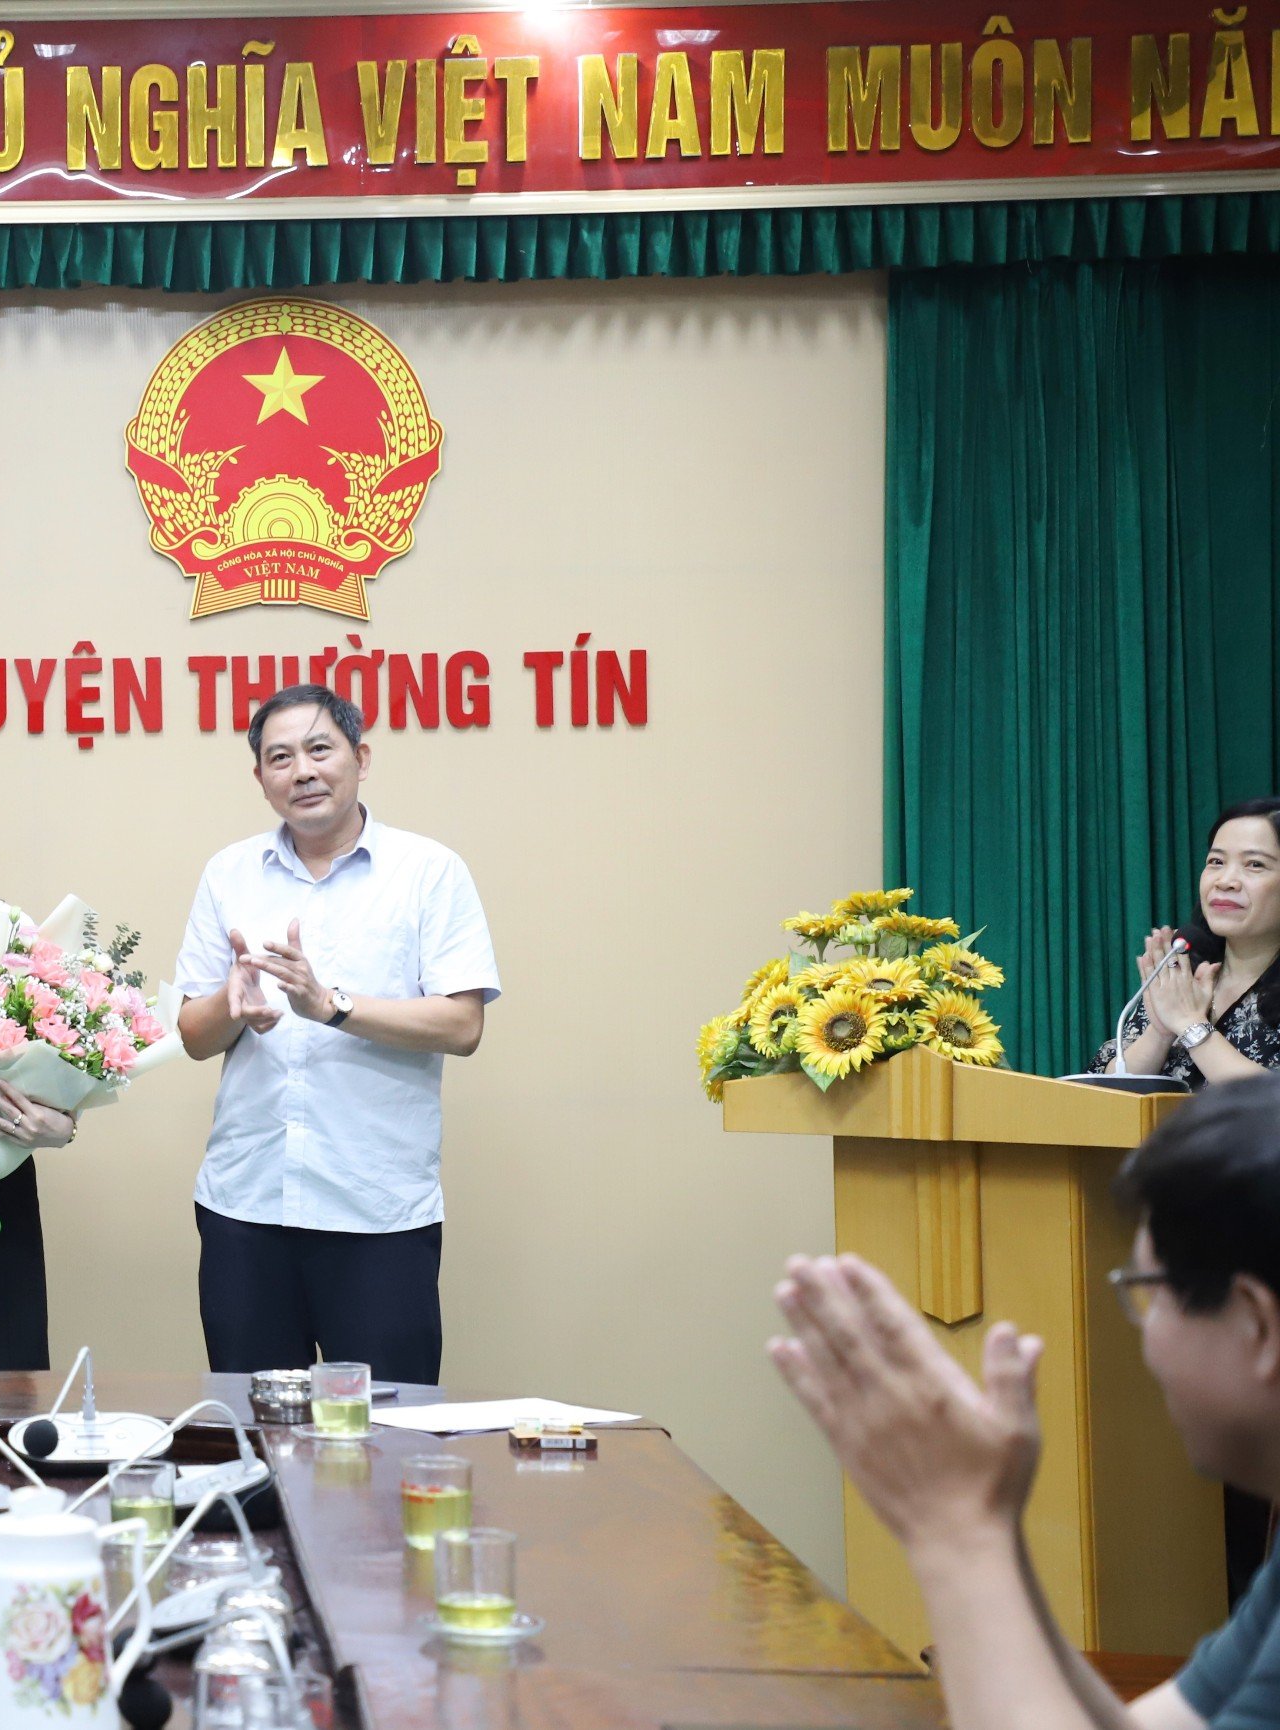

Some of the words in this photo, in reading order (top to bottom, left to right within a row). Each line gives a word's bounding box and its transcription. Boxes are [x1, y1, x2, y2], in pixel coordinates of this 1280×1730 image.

[66, 39, 330, 172] NGHĨA
[357, 34, 541, 187] VIỆT
[578, 48, 787, 160] NAM
[827, 15, 1093, 153] MUÔN
[1130, 6, 1280, 141] NĂ
[243, 560, 281, 578] VIỆT
[285, 562, 321, 579] NAM
[523, 632, 648, 727] TÍN
